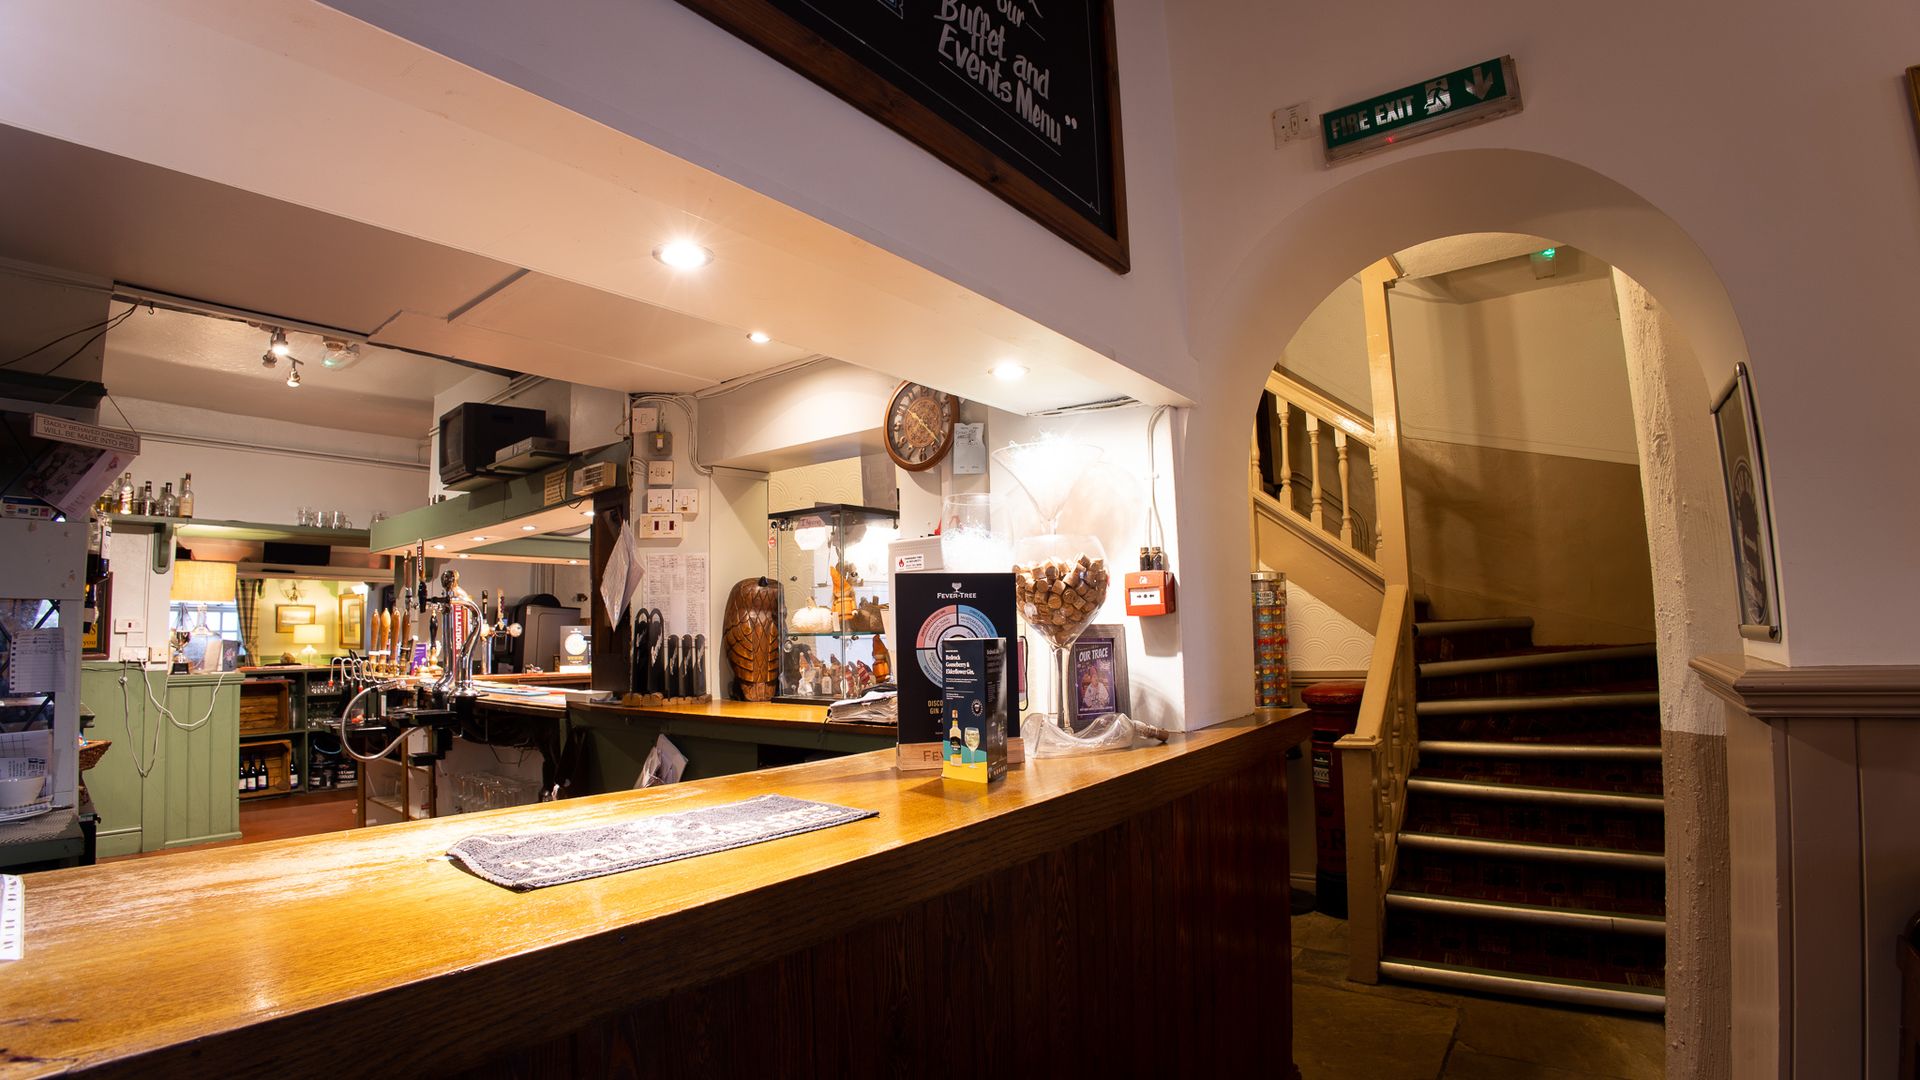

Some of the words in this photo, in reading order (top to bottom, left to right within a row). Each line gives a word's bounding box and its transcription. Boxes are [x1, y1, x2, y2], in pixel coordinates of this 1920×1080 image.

[934, 0, 1007, 63] Buffet
[1012, 54, 1050, 100] and
[938, 24, 1013, 104] Events
[1330, 109, 1370, 140] FIRE
[1375, 95, 1415, 126] EXIT
[43, 418, 68, 430] BADLY
[68, 424, 101, 437] BEHAVED
[101, 431, 134, 443] CHILDREN
[44, 426, 63, 437] WILL
[65, 430, 76, 438] BE
[77, 432, 99, 443] MADE
[100, 437, 118, 446] INTO
[118, 441, 135, 450] PIES
[1079, 650, 1091, 662] OUR
